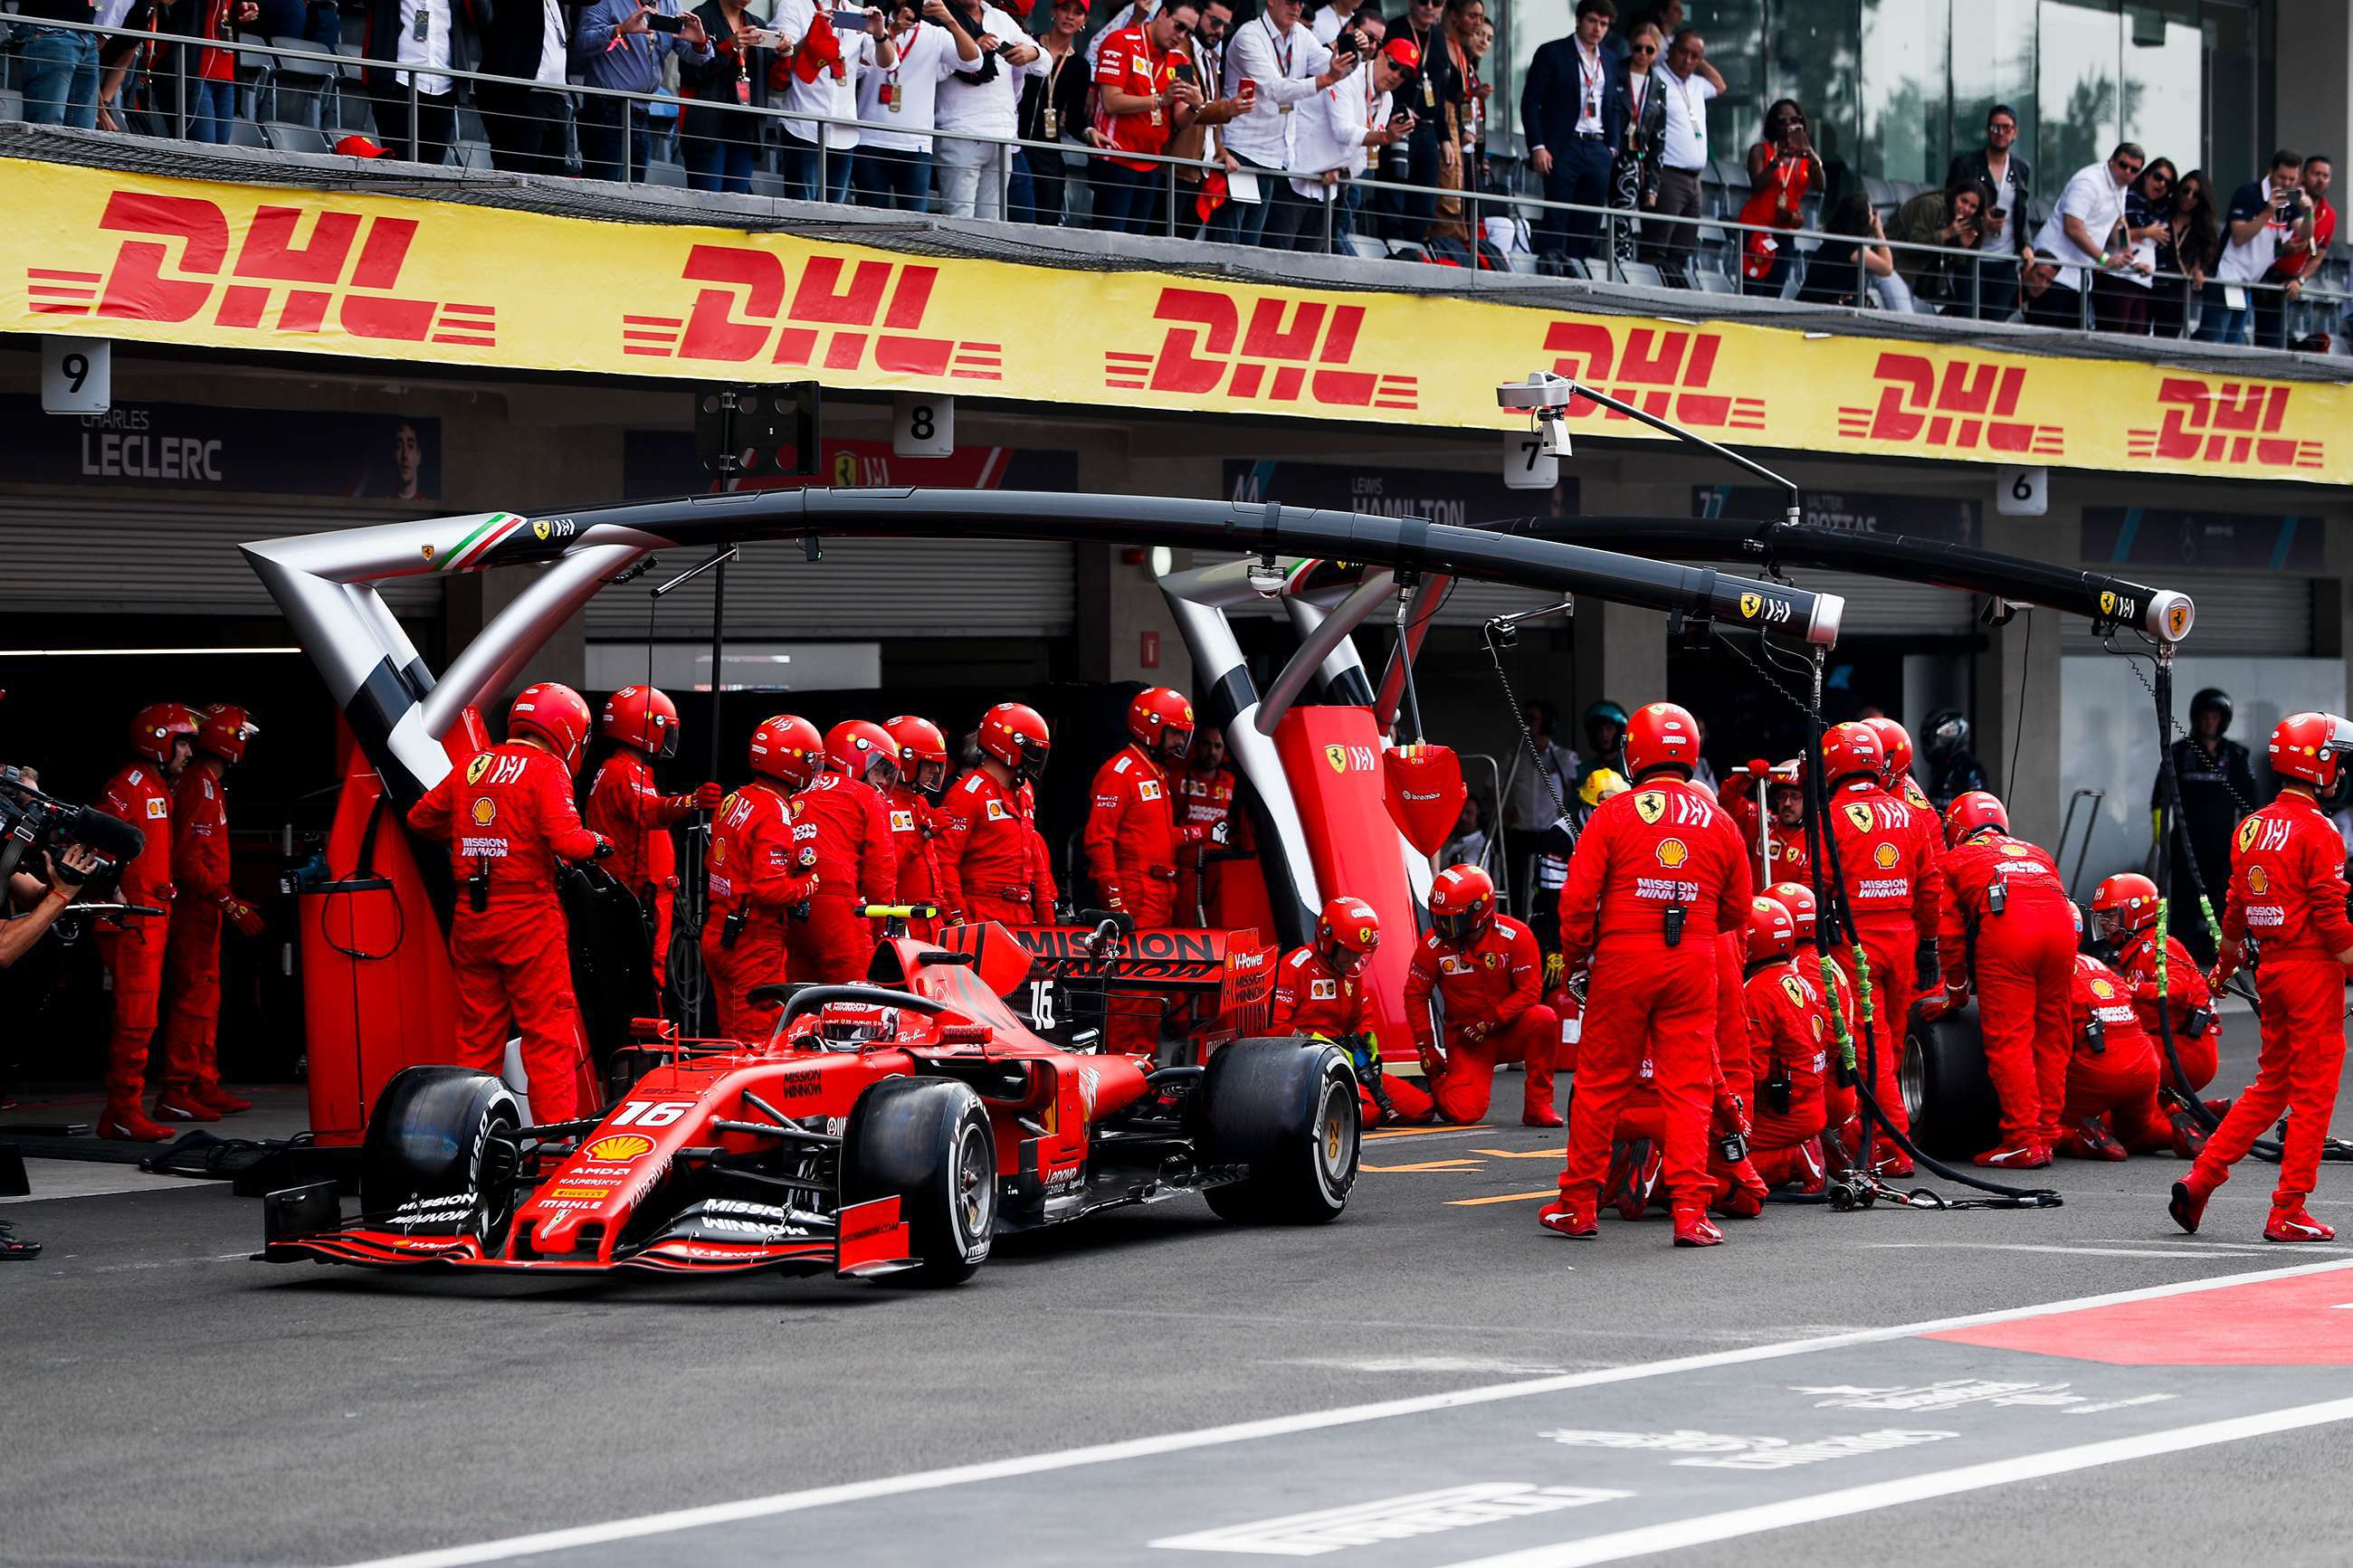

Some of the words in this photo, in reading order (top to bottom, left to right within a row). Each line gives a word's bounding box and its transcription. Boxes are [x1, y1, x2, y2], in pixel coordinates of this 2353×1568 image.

[96, 191, 438, 342] DHL
[678, 244, 955, 376] DHL
[1150, 288, 1378, 405] DHL
[62, 354, 90, 394] 9
[1542, 321, 1731, 427] DHL
[1870, 352, 2035, 452] DHL
[910, 405, 935, 440] 8
[2155, 378, 2298, 466] DHL
[81, 432, 222, 481] LECLERC
[1521, 442, 1540, 471] 7
[1352, 478, 1383, 495] LEWIS
[2012, 474, 2033, 500] 6
[1636, 878, 1700, 891] MISSION
[1858, 888, 1908, 898] WINNOW
[1859, 879, 1907, 889] MISSION
[1234, 953, 1263, 966] V-Power
[1030, 980, 1055, 1030] 16
[897, 1026, 927, 1043] Ray-Ban
[784, 1069, 822, 1085] MISSION
[783, 1084, 823, 1099] WINNOW
[610, 1101, 698, 1126] 16
[1044, 1166, 1077, 1186] Lenovo
[397, 1193, 479, 1212] MISSION
[538, 1201, 603, 1210] MAHLE
[702, 1198, 814, 1221] MISSION
[701, 1216, 809, 1236] WINNOW
[691, 1248, 770, 1259] V-Power
